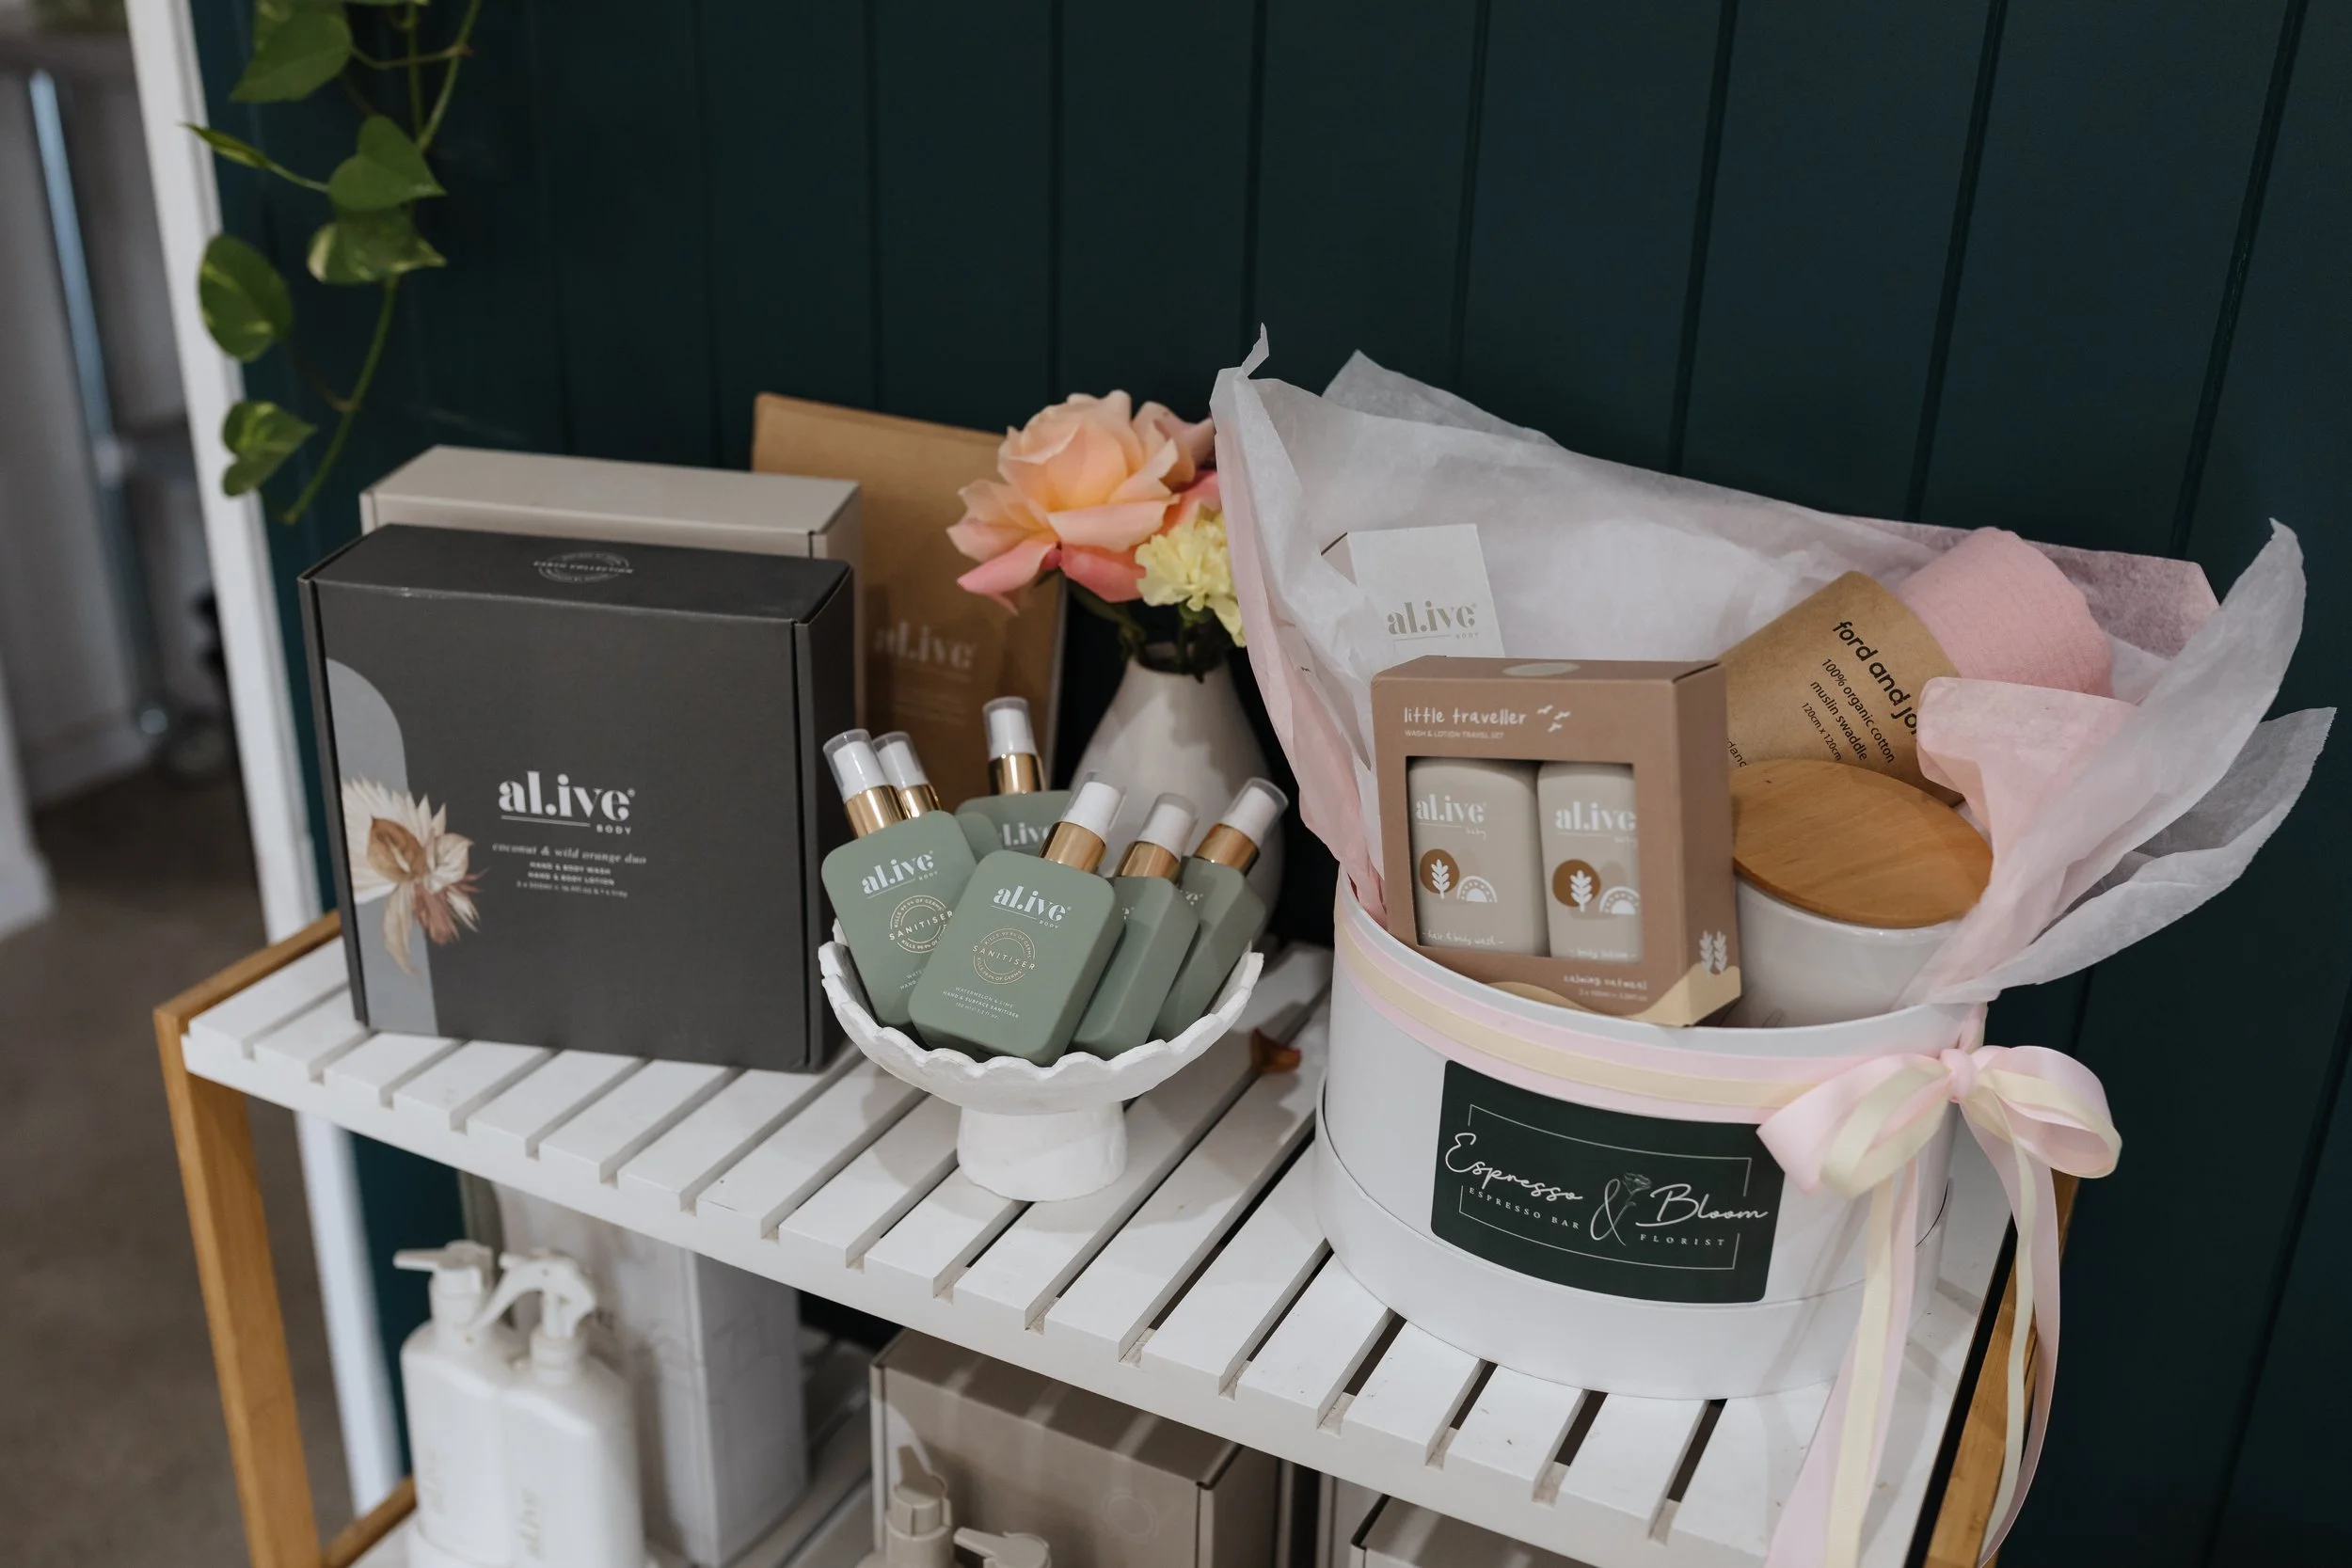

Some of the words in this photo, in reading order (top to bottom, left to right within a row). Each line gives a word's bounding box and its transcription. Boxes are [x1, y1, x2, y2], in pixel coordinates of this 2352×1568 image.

[1387, 600, 1475, 635] al.ive
[1832, 621, 1879, 661] ford
[1868, 661, 1911, 706] and
[1405, 707, 1446, 723] little
[1453, 708, 1527, 725] traveller
[1810, 680, 1839, 716] muslin
[1836, 715, 1867, 760] swaddle
[1821, 658, 1847, 686] 100%
[1843, 687, 1874, 727] organic
[1870, 726, 1895, 764] cotton
[1801, 702, 1821, 731] 120cm
[1823, 734, 1842, 761] 120cm
[499, 770, 630, 822] al.ive
[1416, 794, 1486, 824] al.ive
[596, 824, 631, 835] BODY
[492, 843, 537, 855] coconut
[540, 846, 550, 857] &
[554, 847, 580, 860] wild
[582, 851, 622, 863] orange
[624, 852, 647, 864] duo
[862, 850, 934, 895] al.ive
[993, 885, 1067, 922] al.ive
[889, 911, 953, 941] SANITISER
[1040, 920, 1060, 930] BODY
[972, 945, 1036, 971] SANITISER
[942, 990, 959, 999] HAND
[965, 997, 989, 1008] SURFACE
[990, 1005, 1020, 1018] SANITISER
[955, 987, 993, 1002] WATERMELON
[999, 1001, 1014, 1009] LIME
[1445, 1132, 1583, 1203] Espresso
[1589, 1179, 1628, 1247] &
[1635, 1183, 1769, 1227] Bloom
[1468, 1187, 1543, 1220] ESPRESSO
[1551, 1216, 1581, 1230] BAR
[1639, 1233, 1726, 1246] FLORIST
